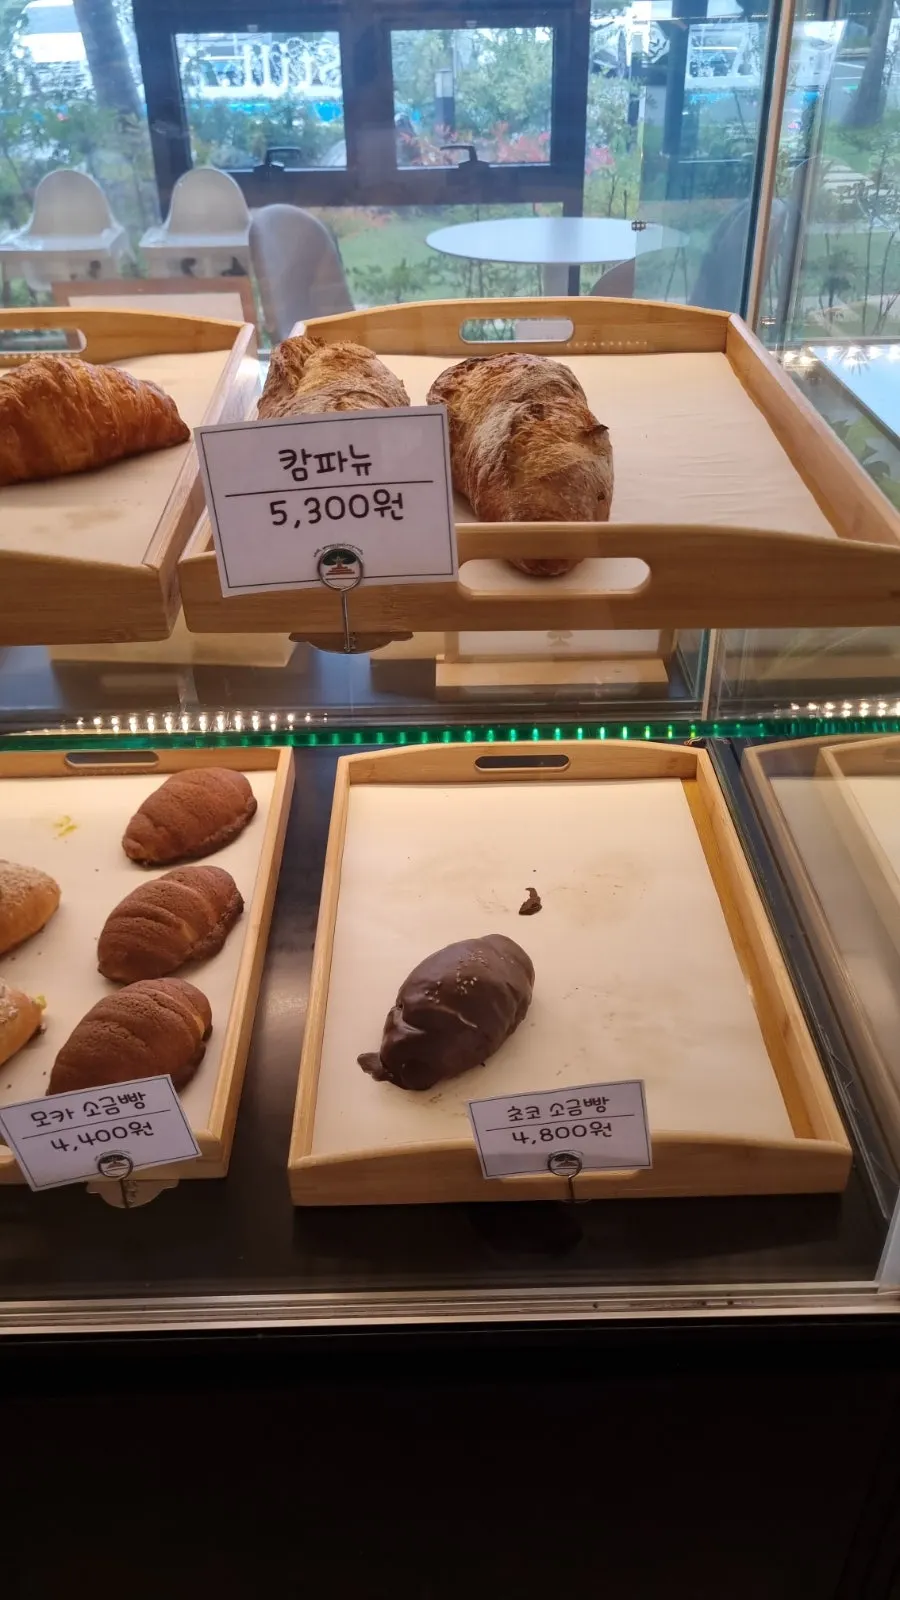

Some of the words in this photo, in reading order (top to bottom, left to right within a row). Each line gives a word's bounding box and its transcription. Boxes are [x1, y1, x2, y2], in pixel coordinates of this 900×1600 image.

[278, 444, 372, 482] 캄파뉴
[269, 488, 404, 529] 5,300원
[30, 1108, 75, 1128] 모카
[83, 1091, 147, 1117] 소금빵
[507, 1105, 541, 1122] 초코
[550, 1096, 610, 1118] 소금빵
[51, 1121, 154, 1152] 4,400원
[512, 1121, 613, 1145] 4,800원
